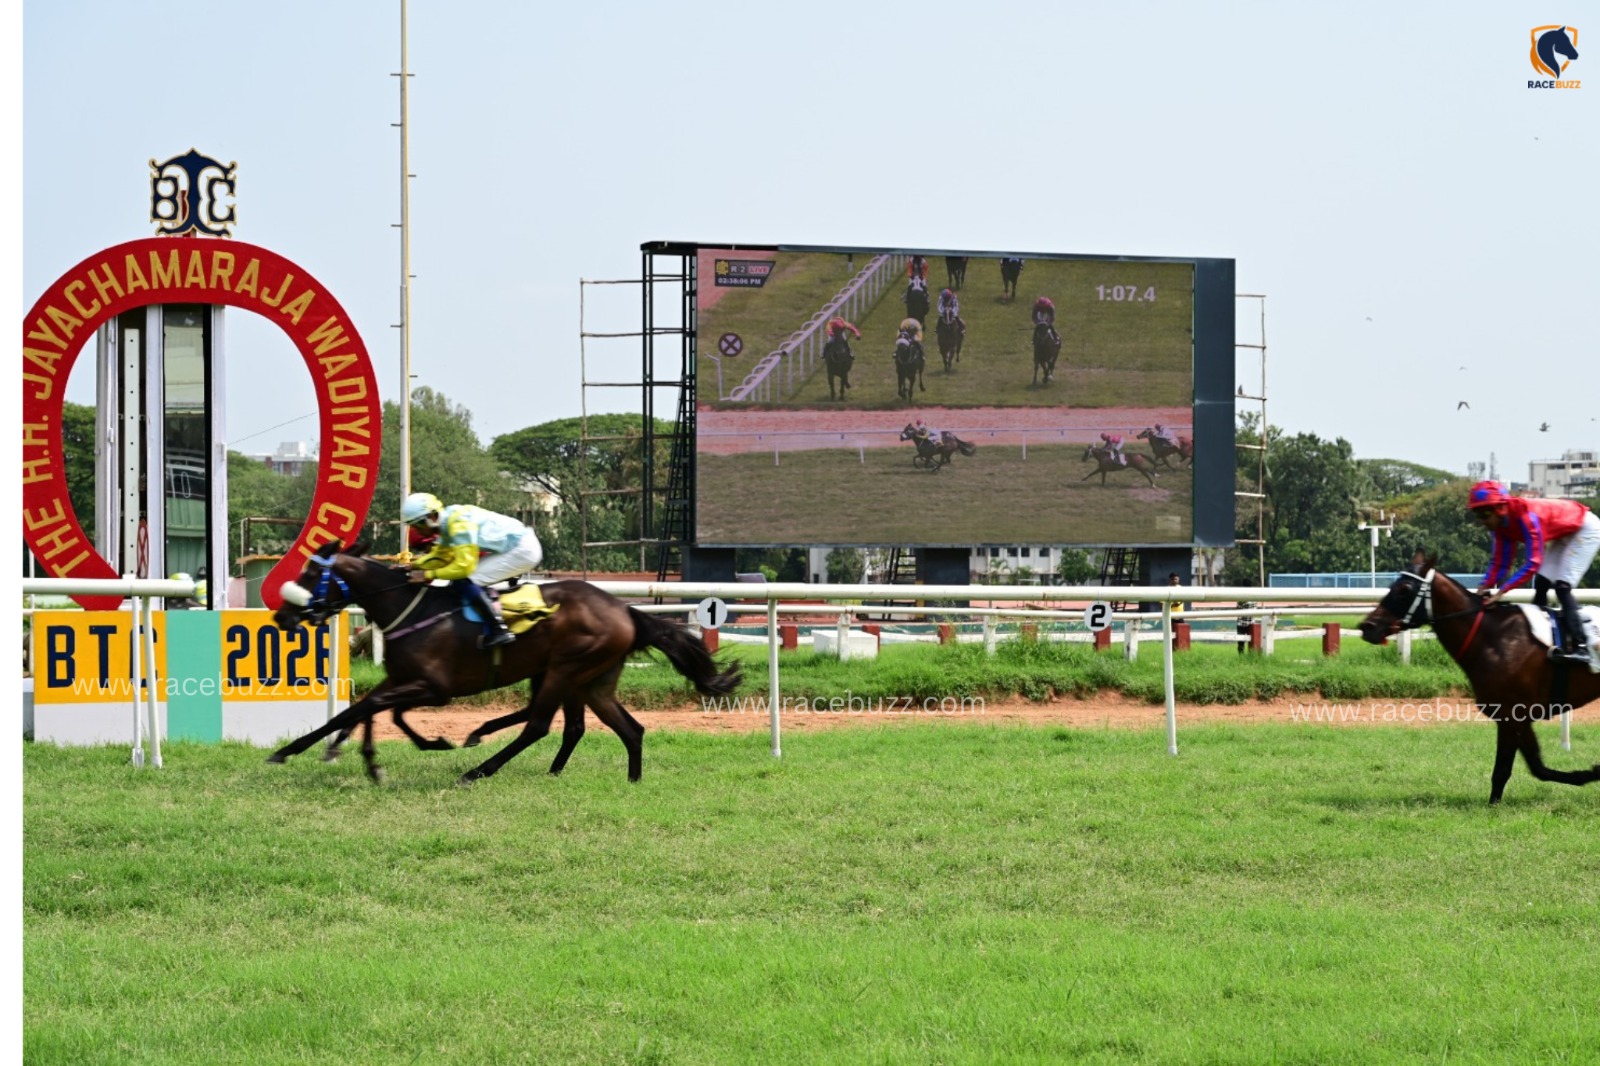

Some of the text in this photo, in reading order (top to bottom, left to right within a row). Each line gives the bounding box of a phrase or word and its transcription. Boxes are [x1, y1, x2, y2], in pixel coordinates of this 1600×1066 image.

[1095, 285, 1156, 302] 1:07.4
[23, 249, 371, 578] THE H.H. JAYACHAMARAJA WADIYAR CU
[707, 601, 716, 625] 1
[1091, 604, 1106, 627] 2
